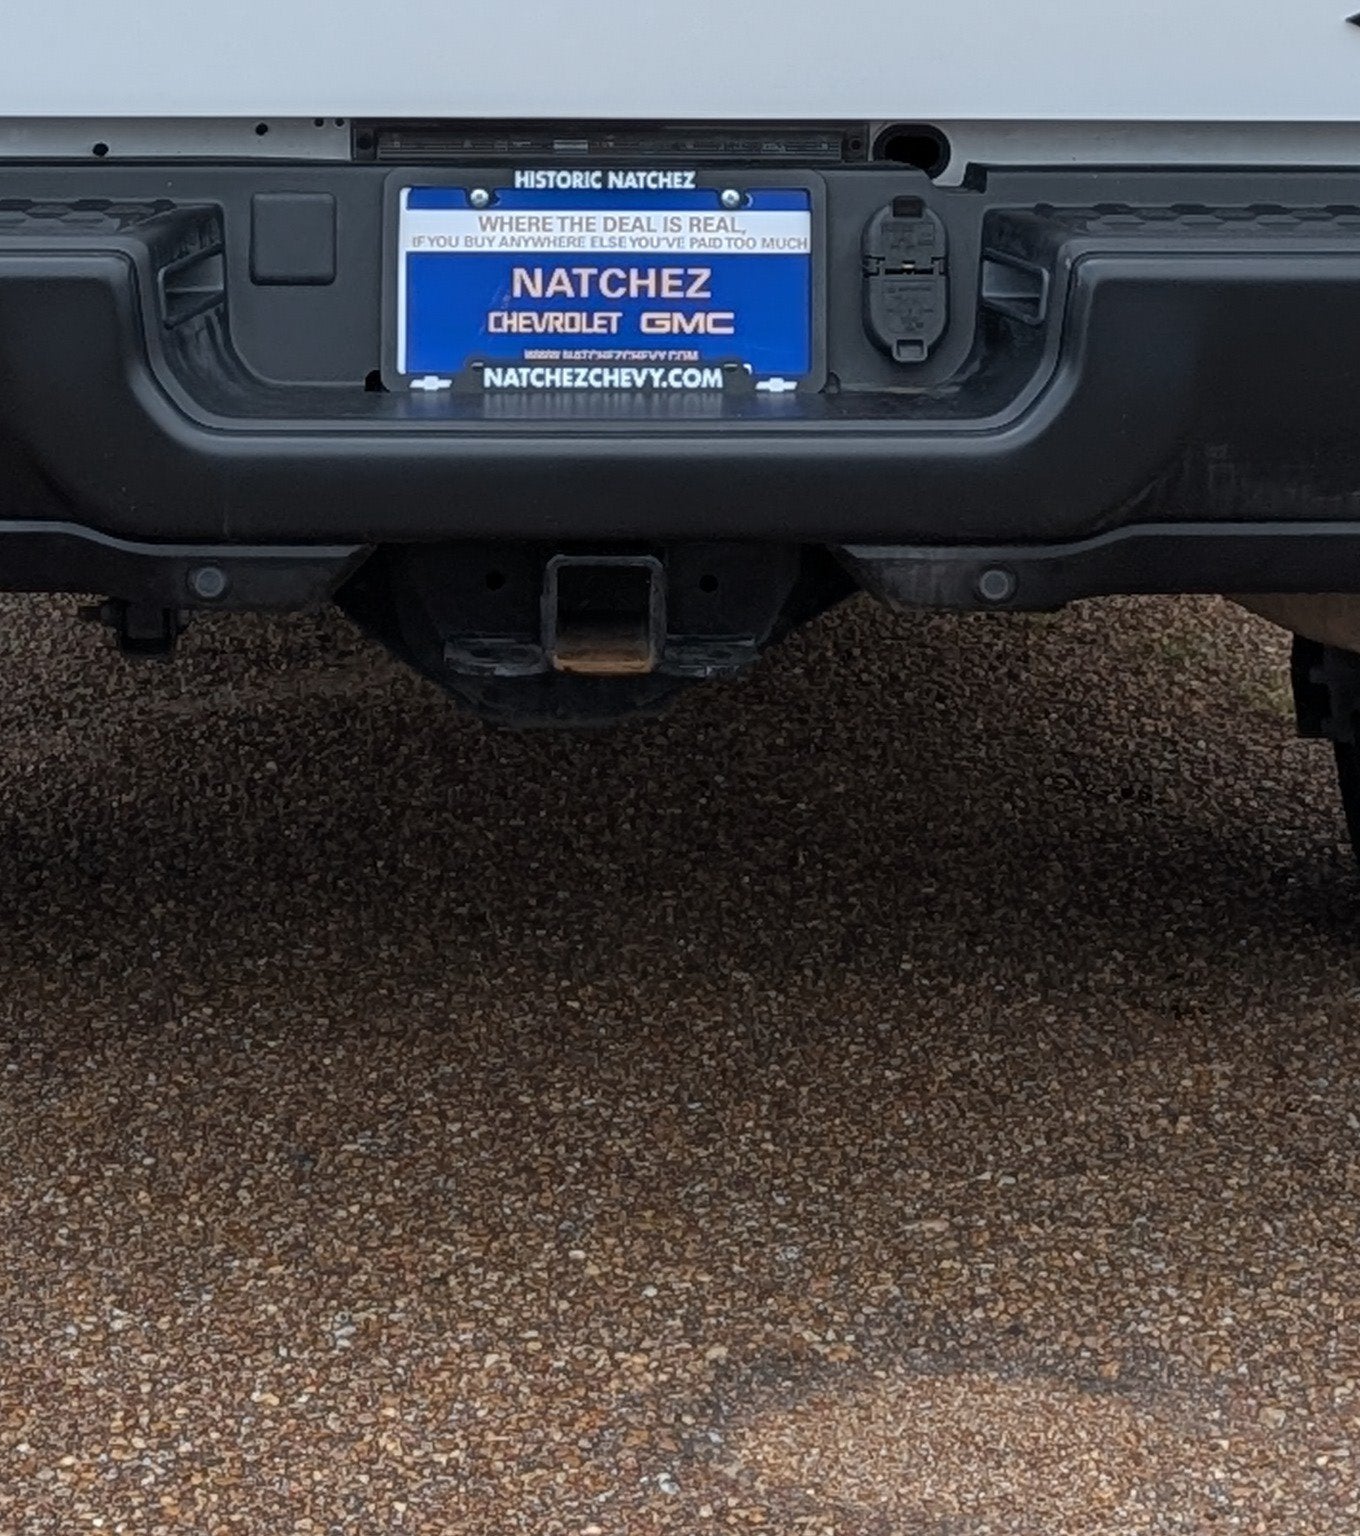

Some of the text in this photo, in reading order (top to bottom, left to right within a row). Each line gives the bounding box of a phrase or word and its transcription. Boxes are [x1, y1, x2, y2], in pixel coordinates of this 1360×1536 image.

[514, 170, 696, 189] HISTORIC NATCHEZ
[478, 216, 746, 235] WHERE THE DEAL IS REAL,
[413, 236, 426, 249] IF
[427, 236, 459, 249] YOU
[464, 236, 496, 249] BUY
[498, 236, 585, 249] ANYWHERE
[590, 236, 627, 249] ELSE
[689, 237, 722, 250] PAID
[725, 237, 757, 250] TOO
[761, 237, 808, 250] MUCH
[512, 267, 712, 299] NATCHEZ
[488, 311, 735, 334] CHEVROLET GMC
[483, 367, 724, 388] NATCHEZCHEVY.COM
